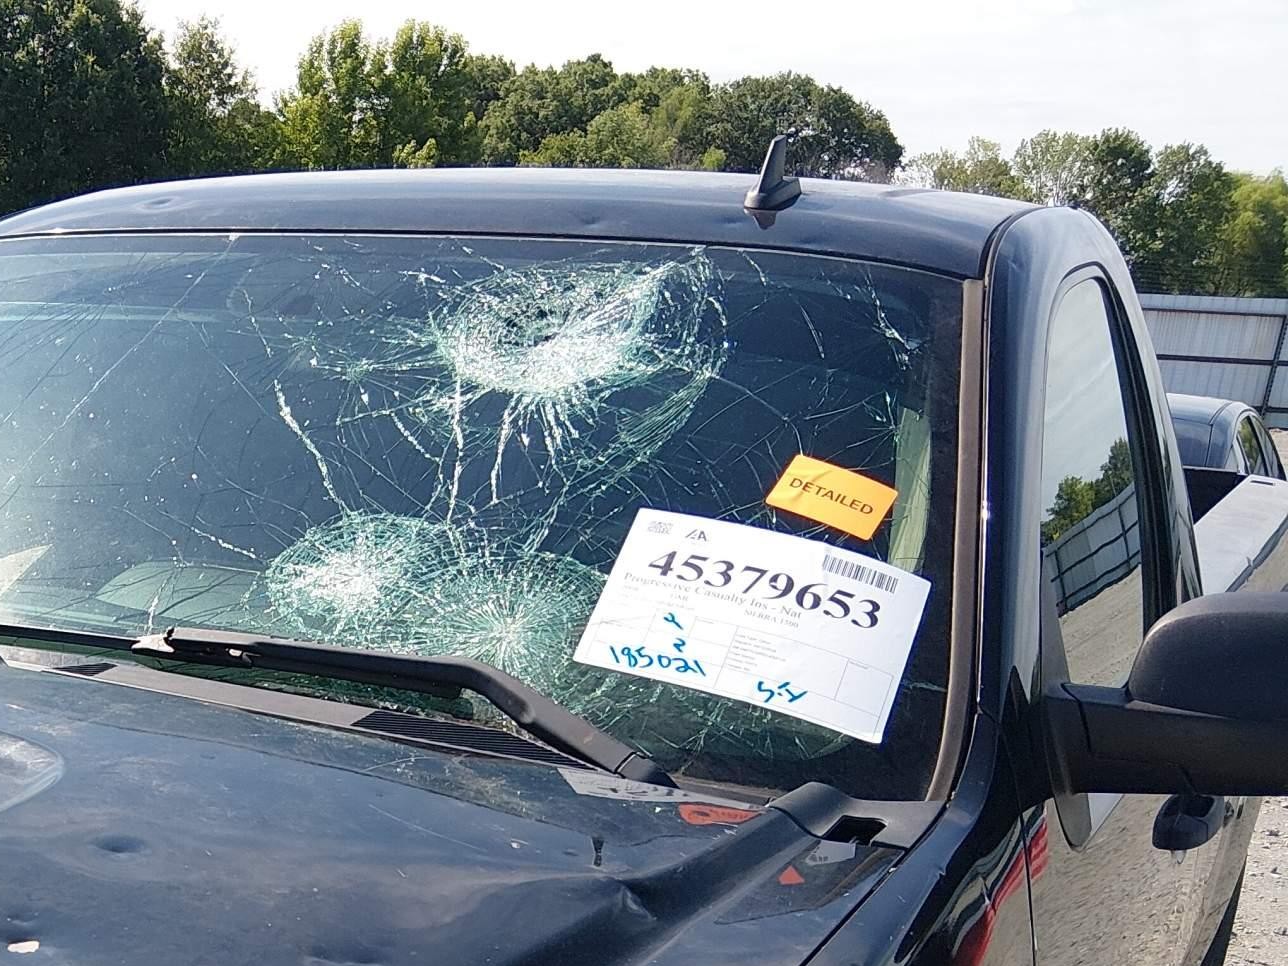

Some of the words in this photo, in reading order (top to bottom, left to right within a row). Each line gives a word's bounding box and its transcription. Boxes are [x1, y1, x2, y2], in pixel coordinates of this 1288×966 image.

[789, 477, 874, 515] DETAILED
[624, 572, 691, 593] Progressive
[694, 587, 747, 605] Casualty
[750, 598, 768, 610] Ins
[780, 606, 802, 619] Nat
[648, 550, 881, 629] 45379653
[744, 609, 777, 623] SIERRA
[609, 645, 707, 677] 185021
